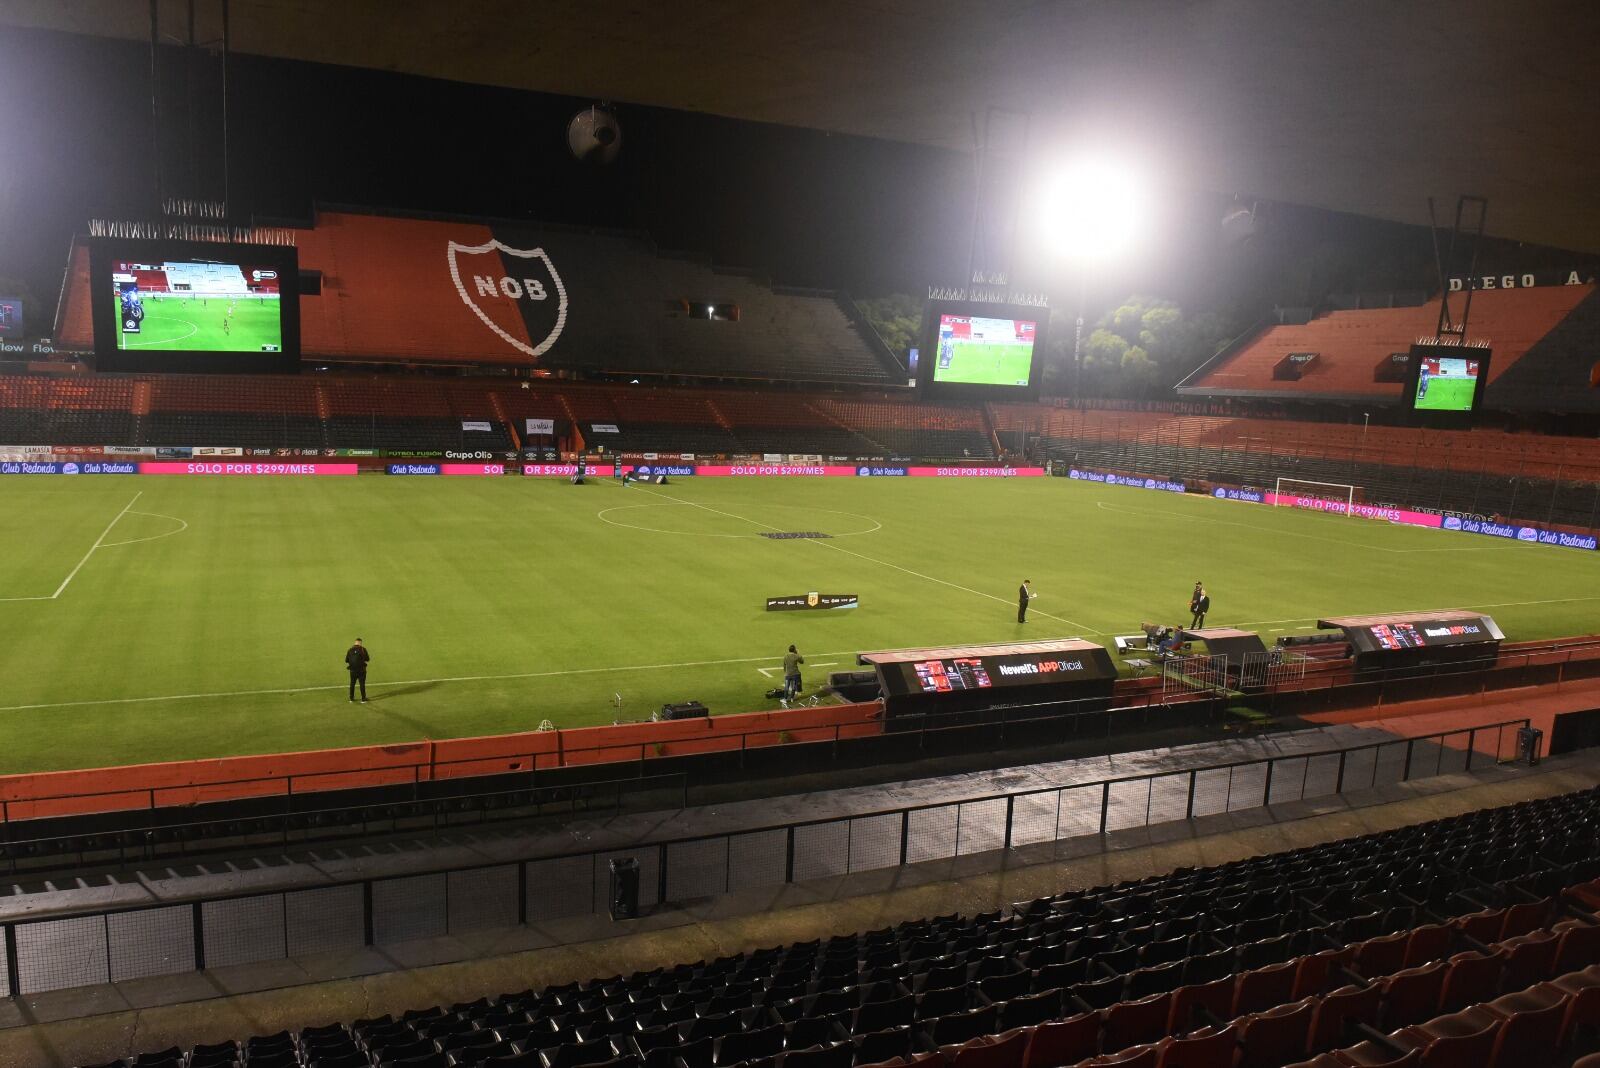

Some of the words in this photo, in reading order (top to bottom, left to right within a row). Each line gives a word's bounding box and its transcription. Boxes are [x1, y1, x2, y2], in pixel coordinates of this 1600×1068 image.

[1565, 270, 1582, 285] A
[473, 275, 547, 300] NOB
[0, 342, 24, 352] low
[445, 450, 473, 460] Grupo
[474, 450, 492, 459] Olio
[2, 462, 20, 473] Club
[22, 463, 56, 473] Redondo
[84, 463, 100, 473] Club
[103, 463, 133, 473] Redondo
[226, 464, 252, 473] POR
[255, 464, 315, 474] $299/MES
[392, 464, 406, 474] Club
[408, 464, 436, 474] Redondo
[759, 467, 778, 475] POR
[781, 467, 825, 475] $299/MES
[1325, 502, 1346, 512] POR
[1462, 520, 1480, 533] Club
[1481, 522, 1514, 538] Redondo
[1538, 530, 1558, 544] Club
[1559, 532, 1597, 550] Redondo
[999, 663, 1039, 676] Newell's
[1038, 661, 1059, 672] APP
